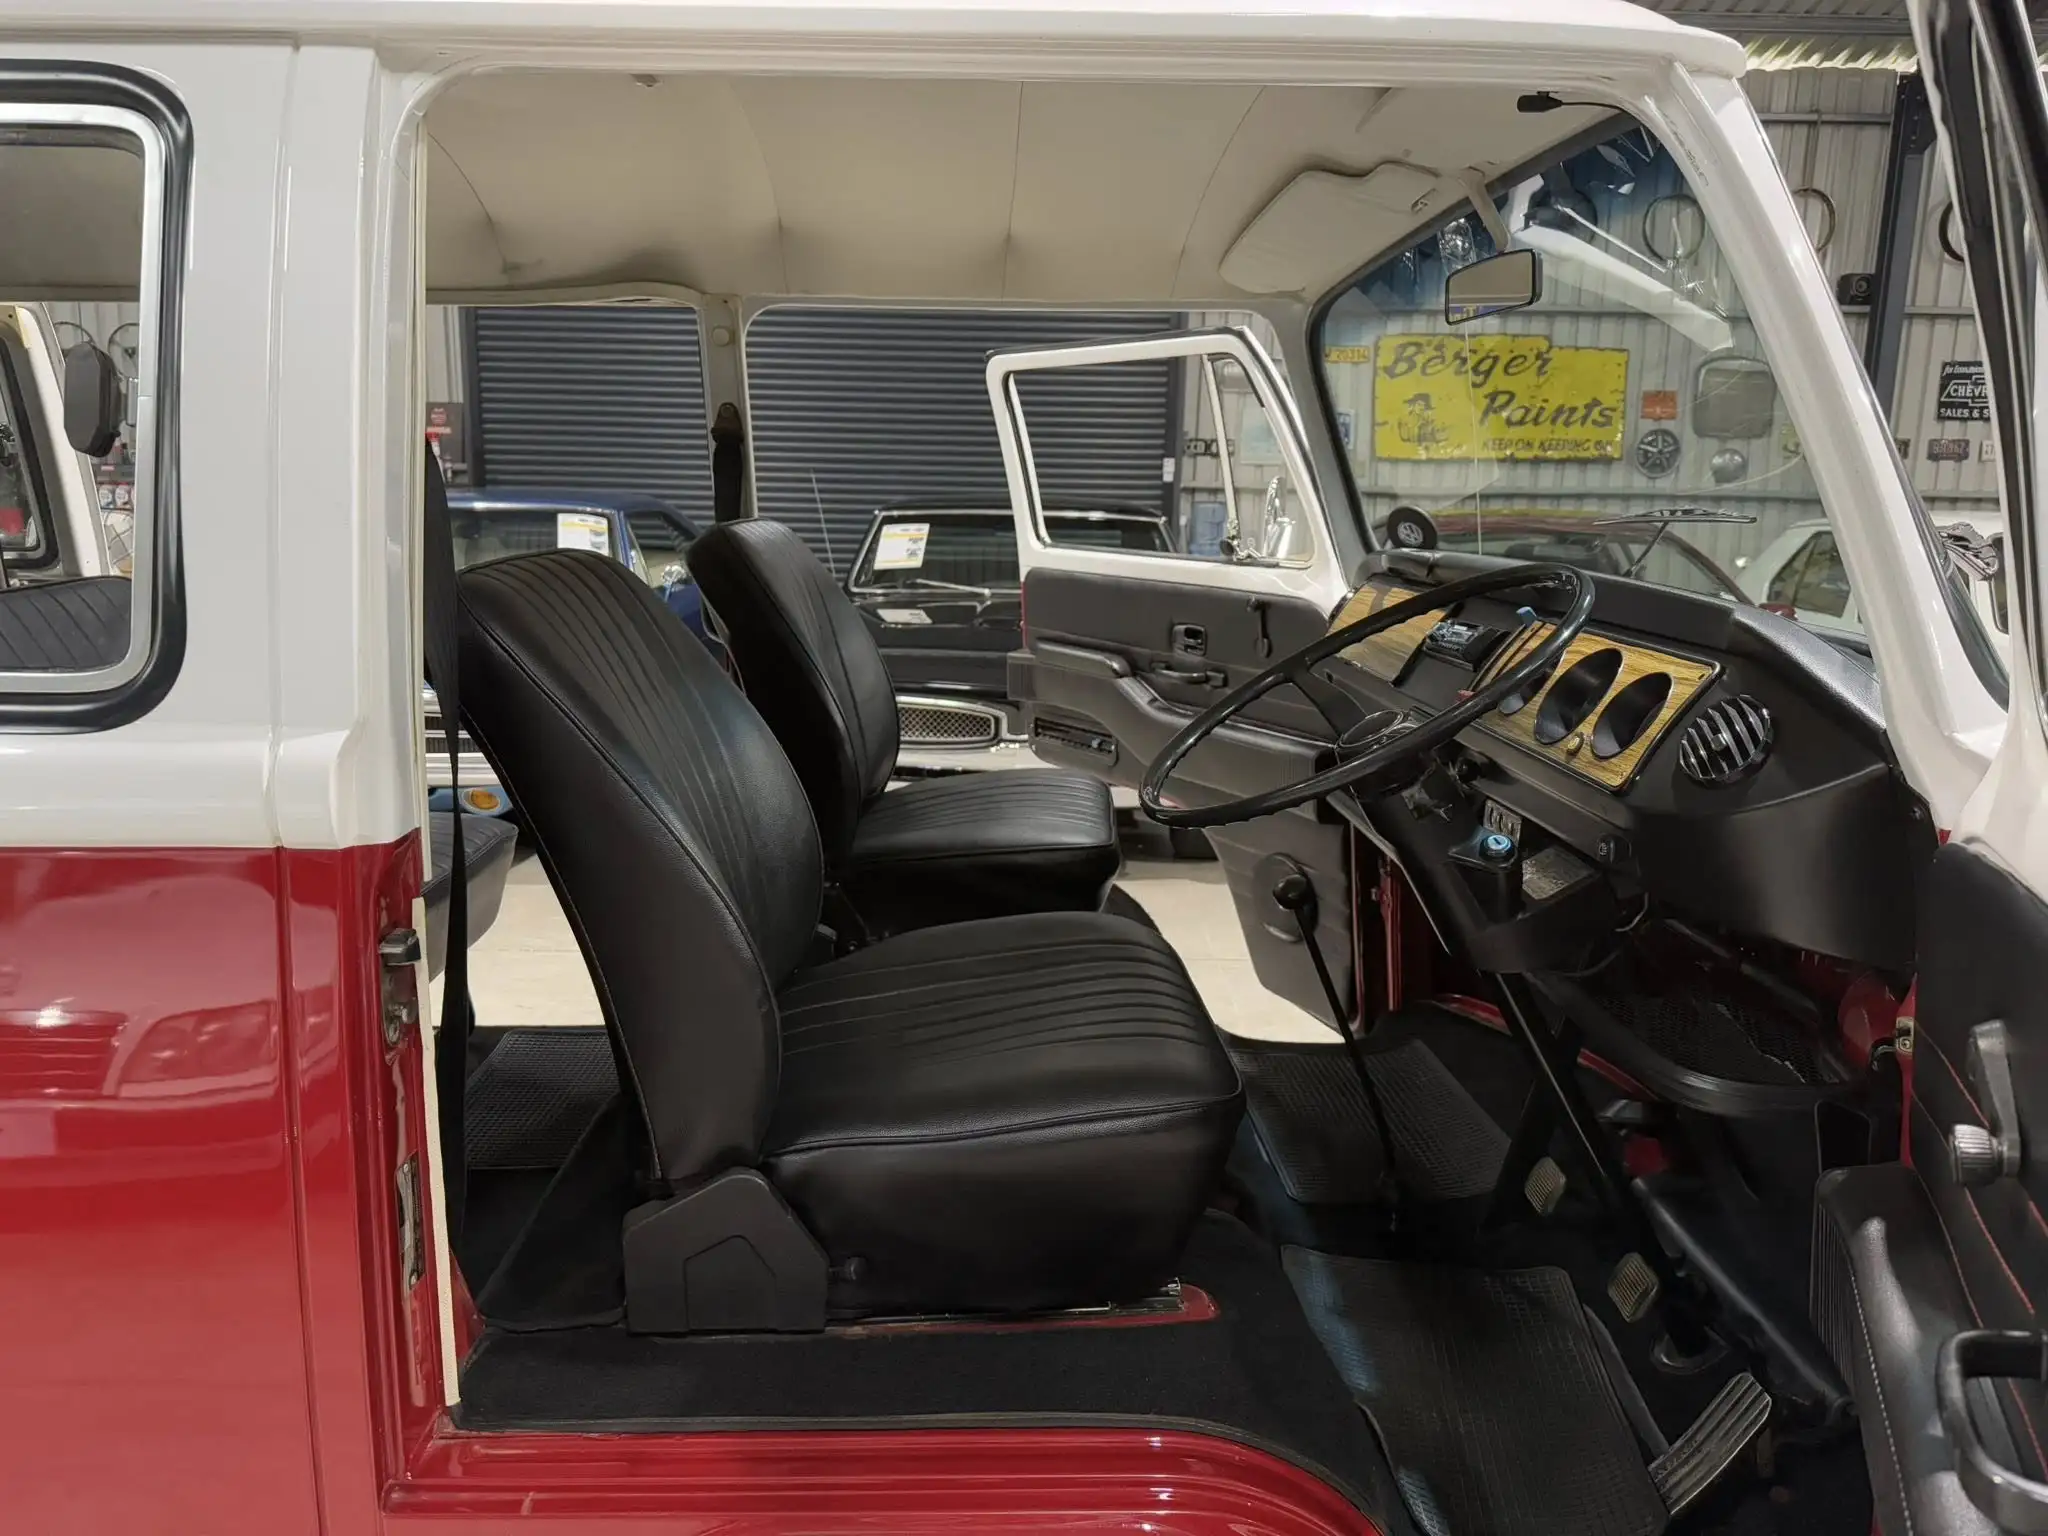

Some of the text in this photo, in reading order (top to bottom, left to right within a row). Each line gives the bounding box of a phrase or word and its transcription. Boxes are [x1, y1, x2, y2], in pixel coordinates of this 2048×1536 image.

[1383, 341, 1553, 388] Berger
[1479, 390, 1617, 429] Paints
[1940, 408, 1970, 418] SALES
[1972, 408, 1980, 418] &
[1482, 438, 1513, 450] KEEP
[1515, 438, 1533, 450] ON
